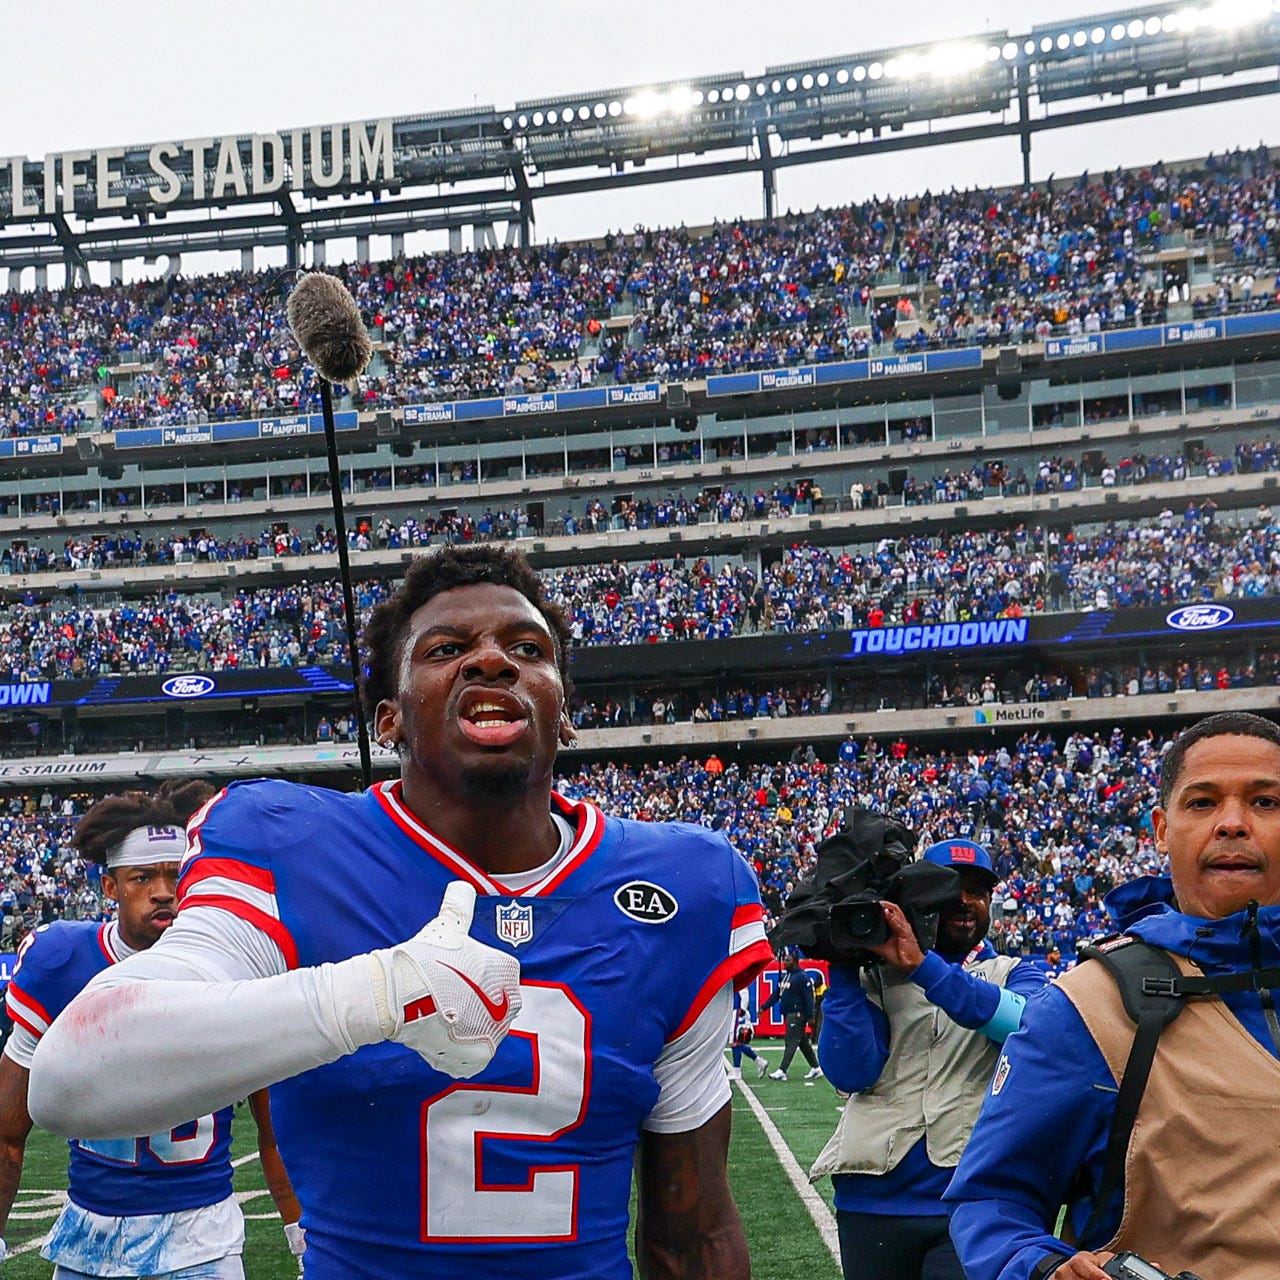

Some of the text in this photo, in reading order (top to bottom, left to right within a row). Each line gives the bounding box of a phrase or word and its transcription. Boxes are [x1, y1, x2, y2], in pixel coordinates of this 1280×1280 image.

[149, 118, 397, 206] STADIUM
[884, 362, 923, 375] MANNING
[776, 374, 813, 387] COUGHLIN
[516, 400, 555, 413] ARMSTEAD
[418, 410, 452, 423] STRAHAN
[176, 431, 211, 443] ANDERSON
[273, 423, 307, 435] HAMPTON
[1179, 608, 1221, 626] Ford
[851, 618, 1029, 653] TOUCHDOWN
[172, 678, 205, 694] Ford
[996, 707, 1046, 723] MetLife
[19, 761, 107, 776] STADIUM
[949, 846, 976, 863] ny
[628, 889, 669, 916] EA
[503, 921, 529, 939] NFL
[421, 978, 592, 1244] 2
